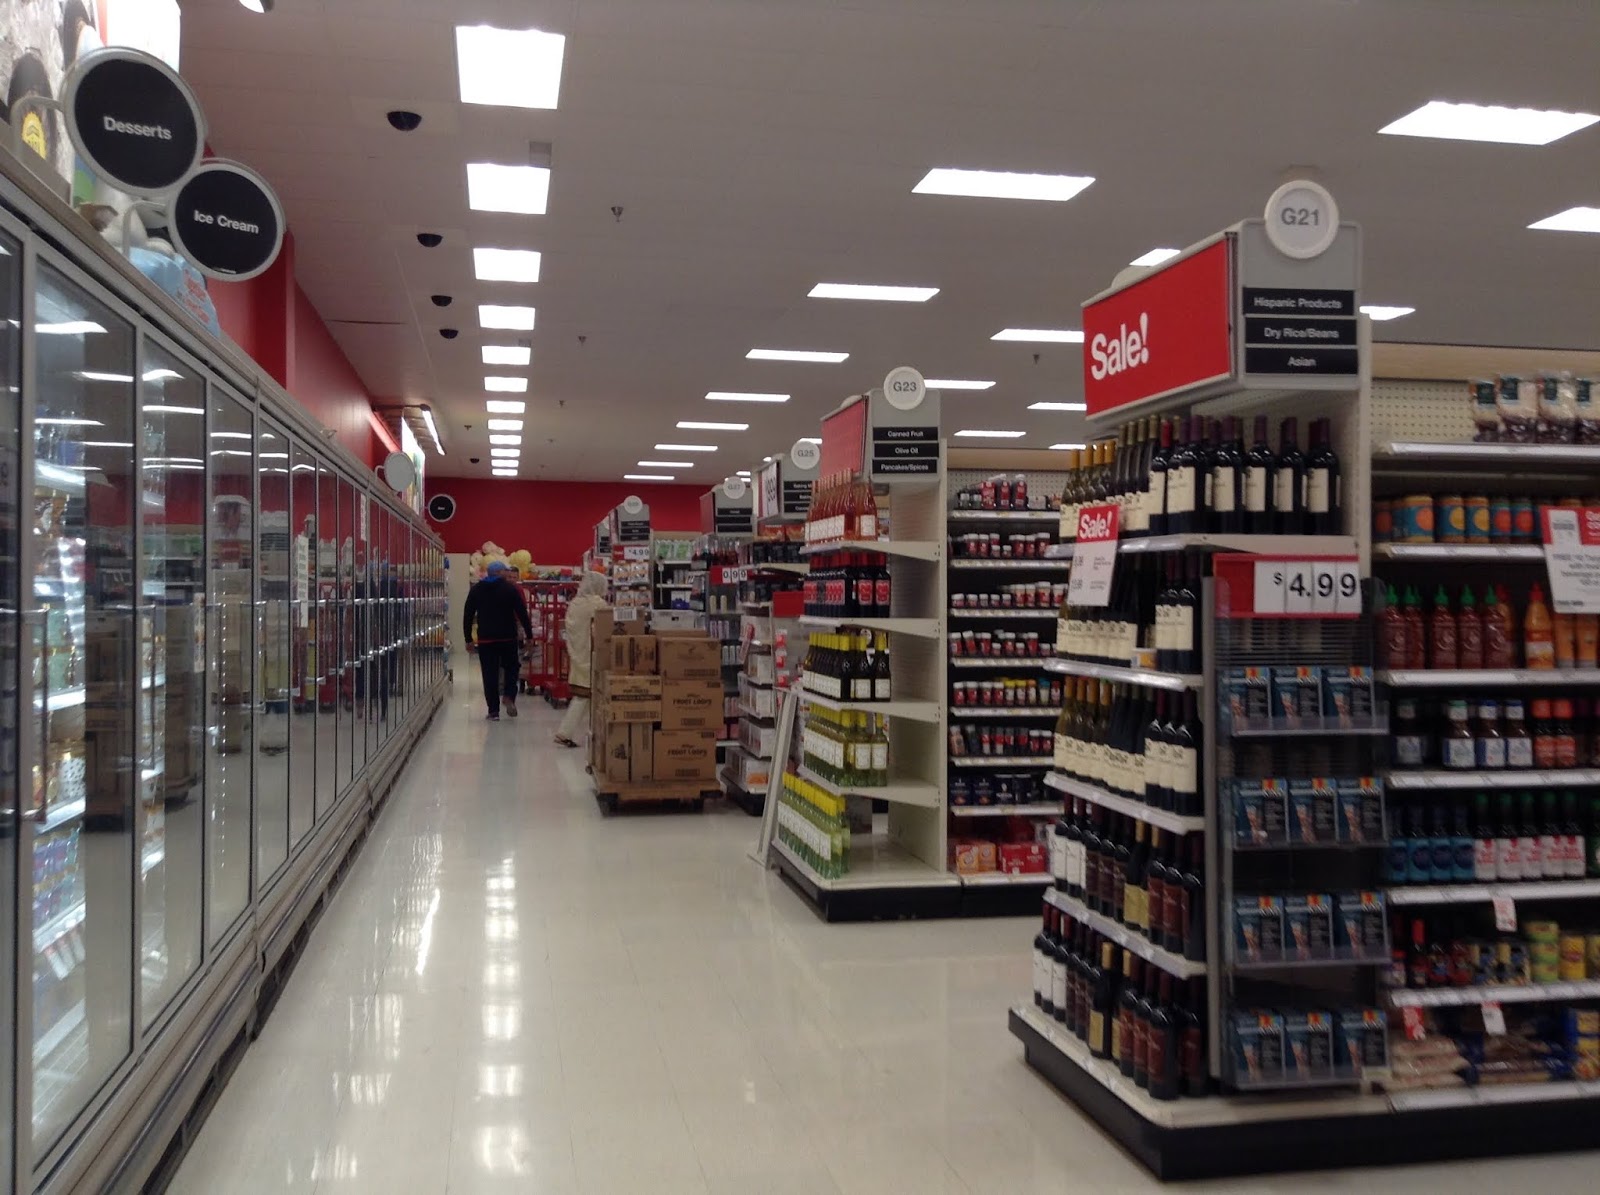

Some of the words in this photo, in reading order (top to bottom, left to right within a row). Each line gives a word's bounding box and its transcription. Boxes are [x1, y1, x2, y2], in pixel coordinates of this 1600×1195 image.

[103, 115, 173, 140] Desserts
[194, 209, 213, 225] Ice
[217, 214, 259, 234] Cream
[1280, 207, 1320, 226] G21
[1254, 297, 1296, 309] Hispanic
[1298, 297, 1342, 309] Products
[1264, 327, 1281, 340] Dry
[1283, 327, 1339, 339] Rice/Beans
[1091, 312, 1148, 380] Sale!
[1287, 356, 1316, 367] Asian
[893, 381, 917, 392] G23
[797, 449, 815, 457] G25
[880, 463, 929, 471] Pancakes/Spices
[1078, 510, 1113, 540] Sale!
[1274, 571, 1358, 598] $4.99
